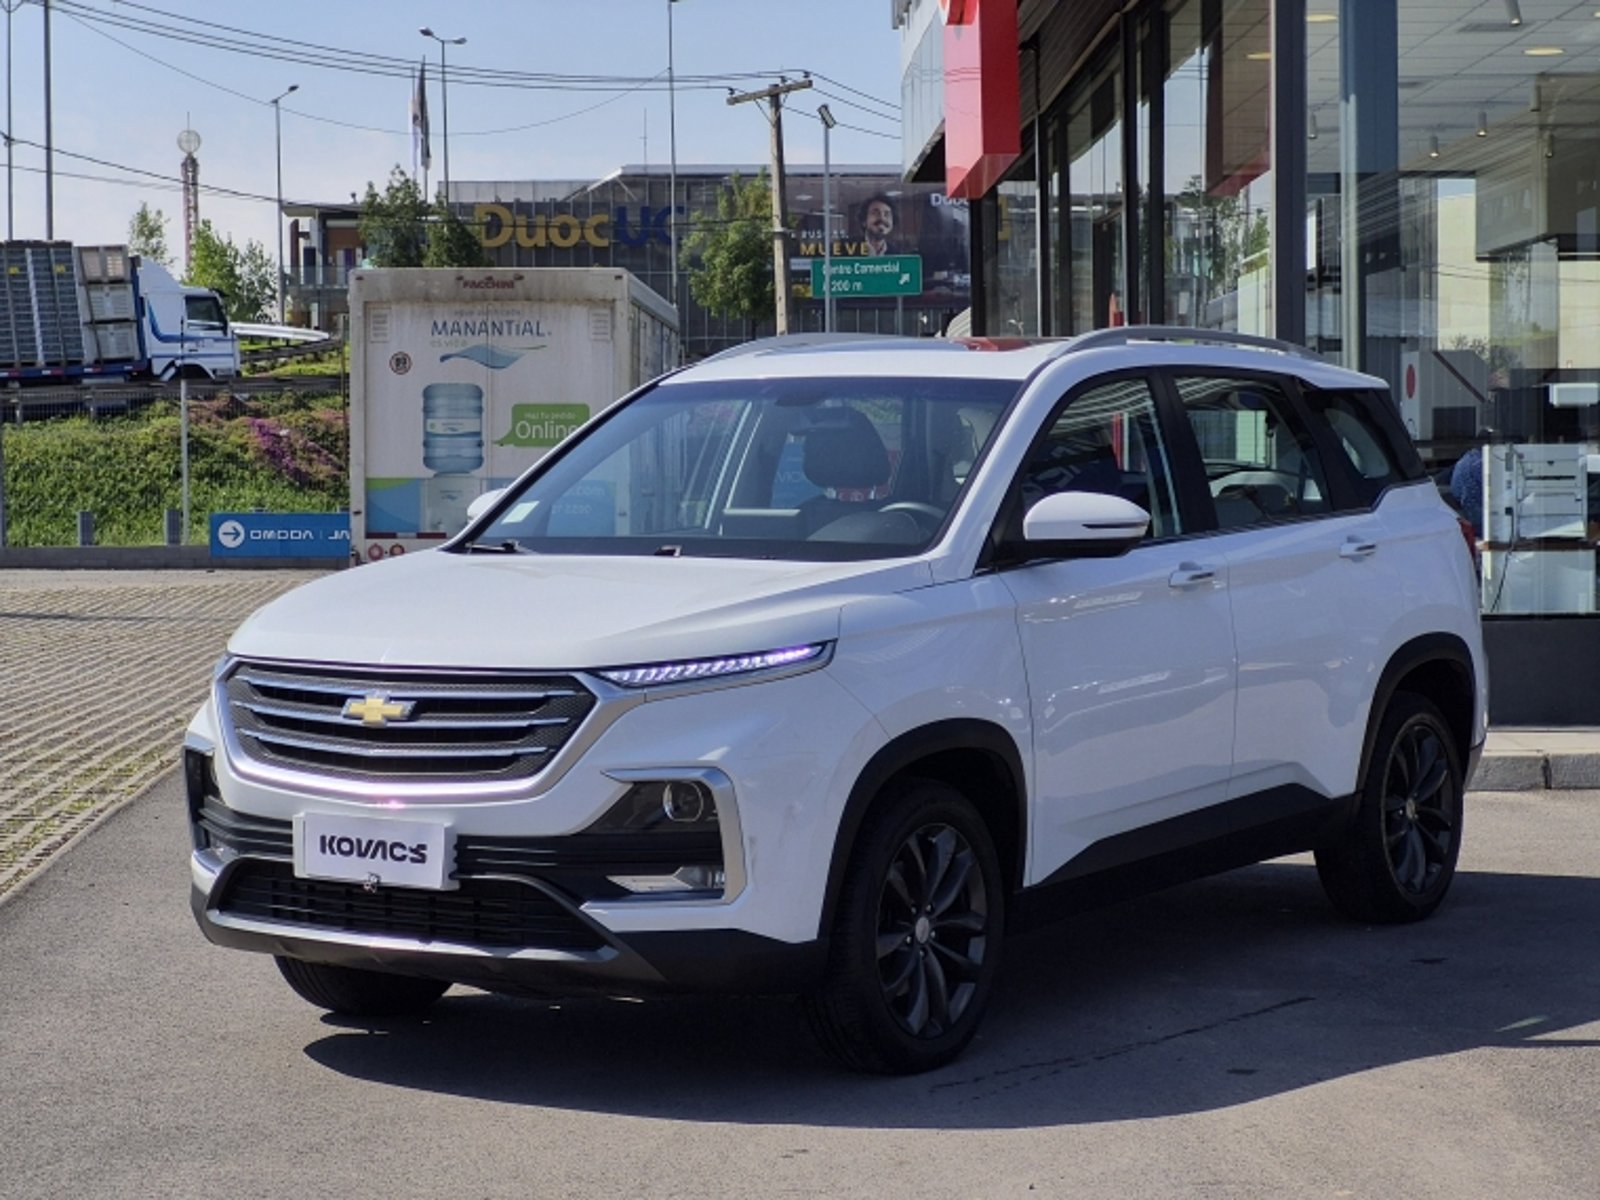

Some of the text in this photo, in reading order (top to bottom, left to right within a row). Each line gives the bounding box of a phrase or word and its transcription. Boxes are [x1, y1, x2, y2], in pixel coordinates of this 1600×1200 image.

[854, 260, 900, 275] Comercial
[463, 280, 515, 289] FACCHINI
[831, 280, 863, 292] 200 m
[250, 530, 314, 540] OMODA
[320, 834, 428, 864] KOVACS
